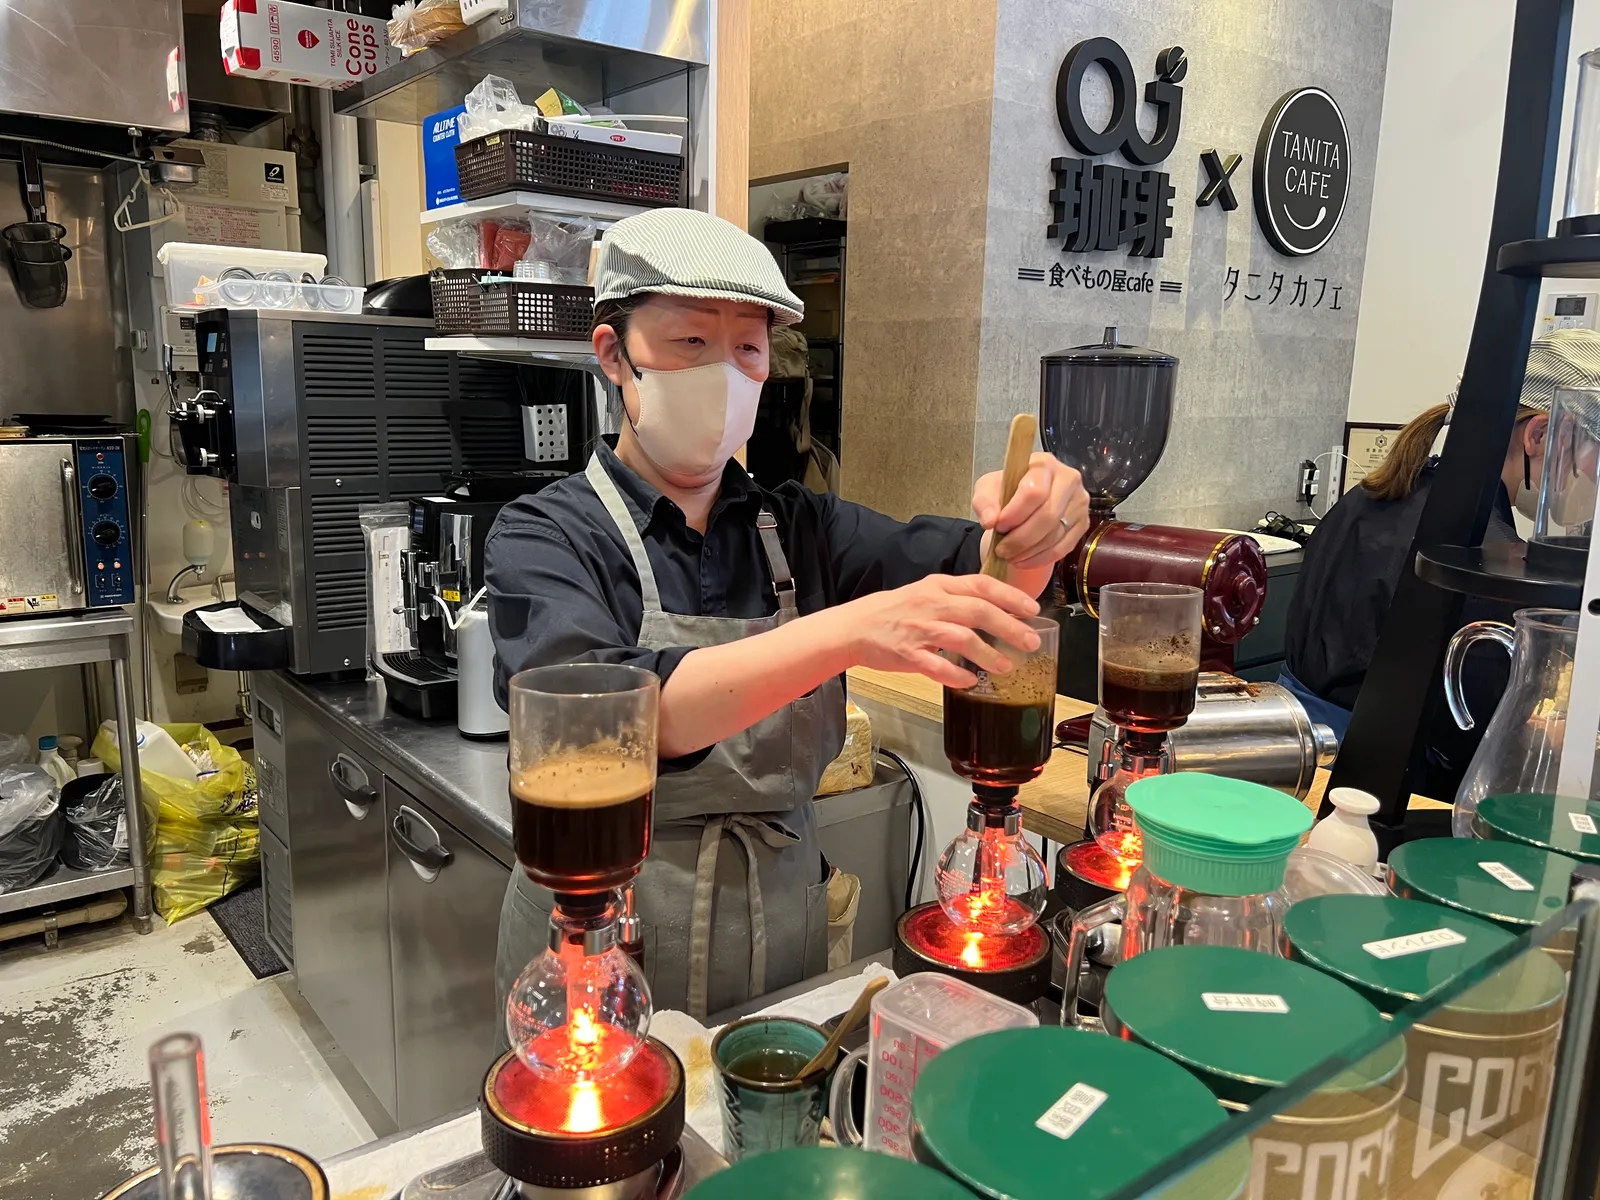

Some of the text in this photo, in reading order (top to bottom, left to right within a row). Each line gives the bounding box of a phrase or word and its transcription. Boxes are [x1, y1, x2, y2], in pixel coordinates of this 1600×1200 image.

[345, 18, 362, 76] Cone
[362, 24, 380, 75] cups
[1282, 130, 1341, 170] TANITA
[1285, 166, 1331, 200] CAFE
[1047, 157, 1176, 258] 珈琲
[1049, 262, 1154, 293] 食べもの屋cafe
[1224, 266, 1343, 311] タニタカフェ
[881, 1050, 905, 1069] 100
[880, 1084, 903, 1103] 200
[878, 1116, 901, 1135] 300
